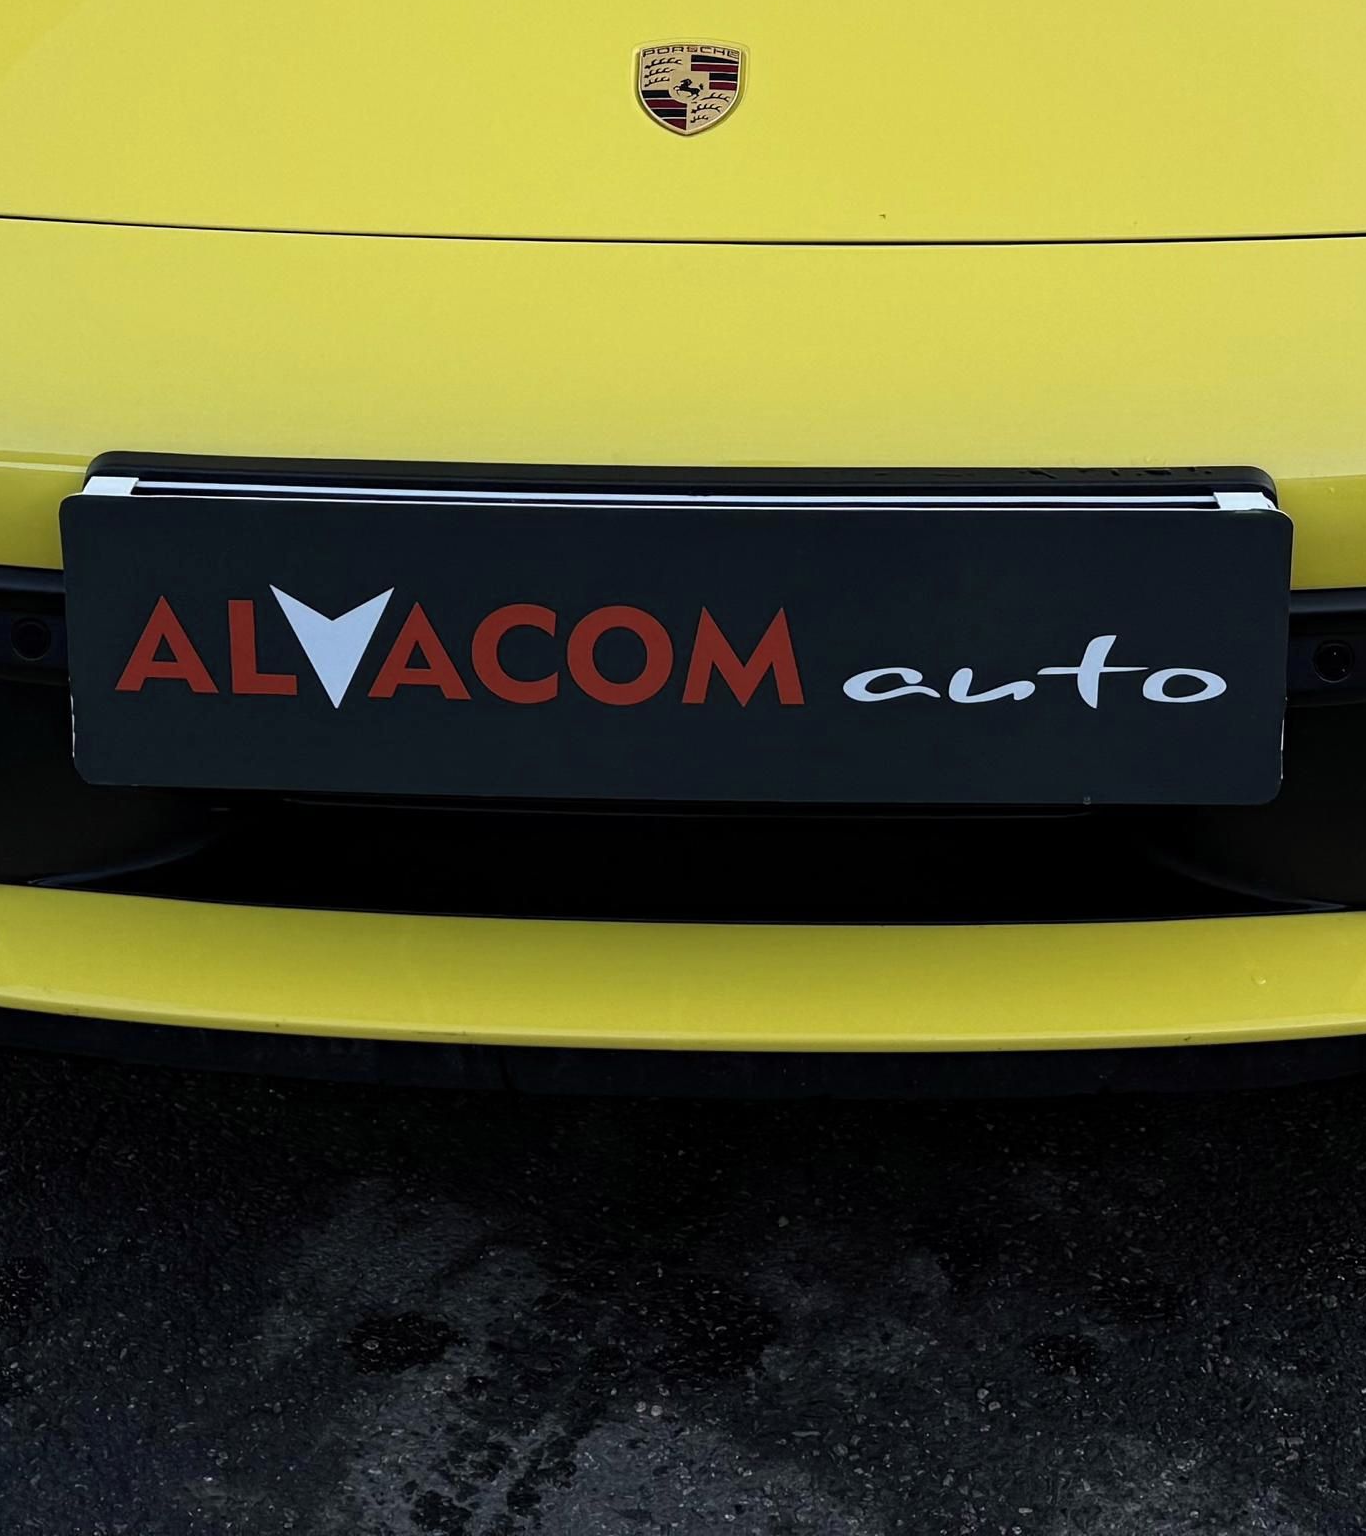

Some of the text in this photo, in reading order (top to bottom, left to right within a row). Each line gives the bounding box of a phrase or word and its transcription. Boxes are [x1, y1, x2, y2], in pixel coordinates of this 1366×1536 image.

[642, 45, 740, 60] PORSCHE
[114, 584, 1227, 710] ALVACOM auto
